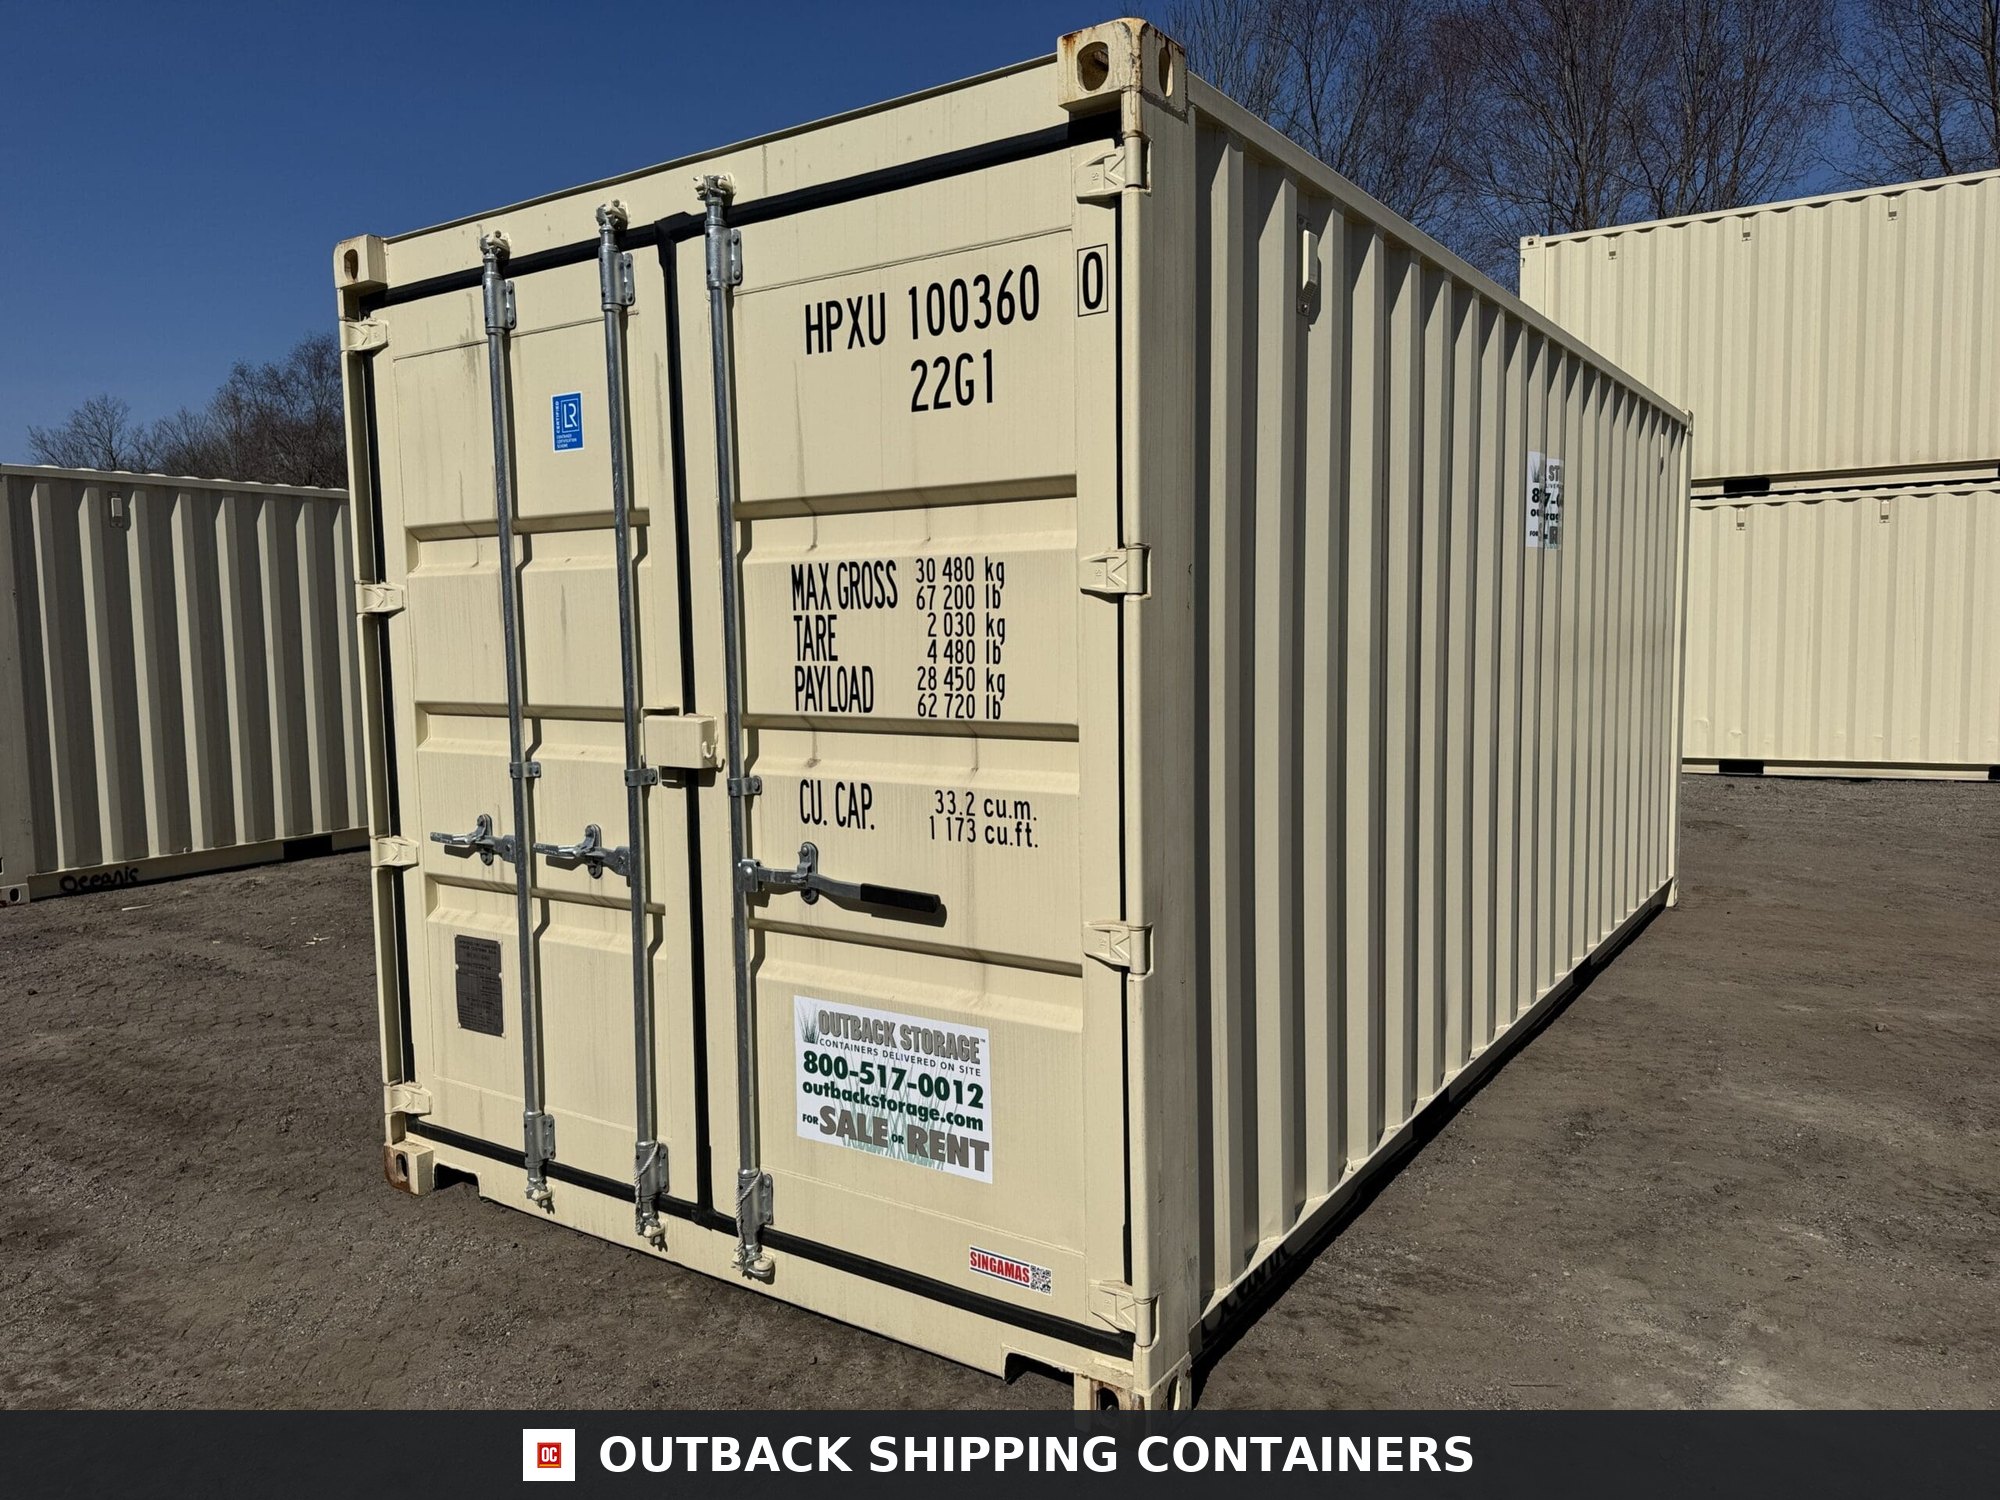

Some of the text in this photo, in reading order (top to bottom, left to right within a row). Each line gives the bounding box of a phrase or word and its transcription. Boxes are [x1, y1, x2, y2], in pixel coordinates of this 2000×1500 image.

[805, 251, 1103, 355] HPXU 100360 0
[910, 349, 993, 412] 22G1
[564, 403, 577, 428] LR
[791, 560, 898, 611] MAX GROSS
[916, 556, 1004, 589] 30 480 kg
[916, 584, 1000, 610] 67 200 lb
[794, 615, 838, 661] TARE
[927, 612, 1005, 645] 2 030 kg
[927, 639, 1000, 664] 4 480 lb
[794, 666, 873, 713] PAYLOAD
[917, 666, 1005, 700] 28 450 kg
[917, 693, 1001, 720] 62 720 lb
[800, 780, 875, 830] CU. CAP.
[935, 790, 1037, 821] 33.2 cu.m.
[930, 816, 1038, 848] 1 173 cu.ft.
[818, 1009, 896, 1048] OUTBACK
[900, 1024, 980, 1064] STORAGE
[819, 1038, 981, 1076] CONTAINERS DELIVERED ON SITE
[803, 1050, 984, 1109] 800-517-0012
[802, 1080, 983, 1131] outbackstorage.com
[802, 1105, 989, 1172] FOR SALE OR RENT
[970, 1251, 1030, 1283] SINGAMAS
